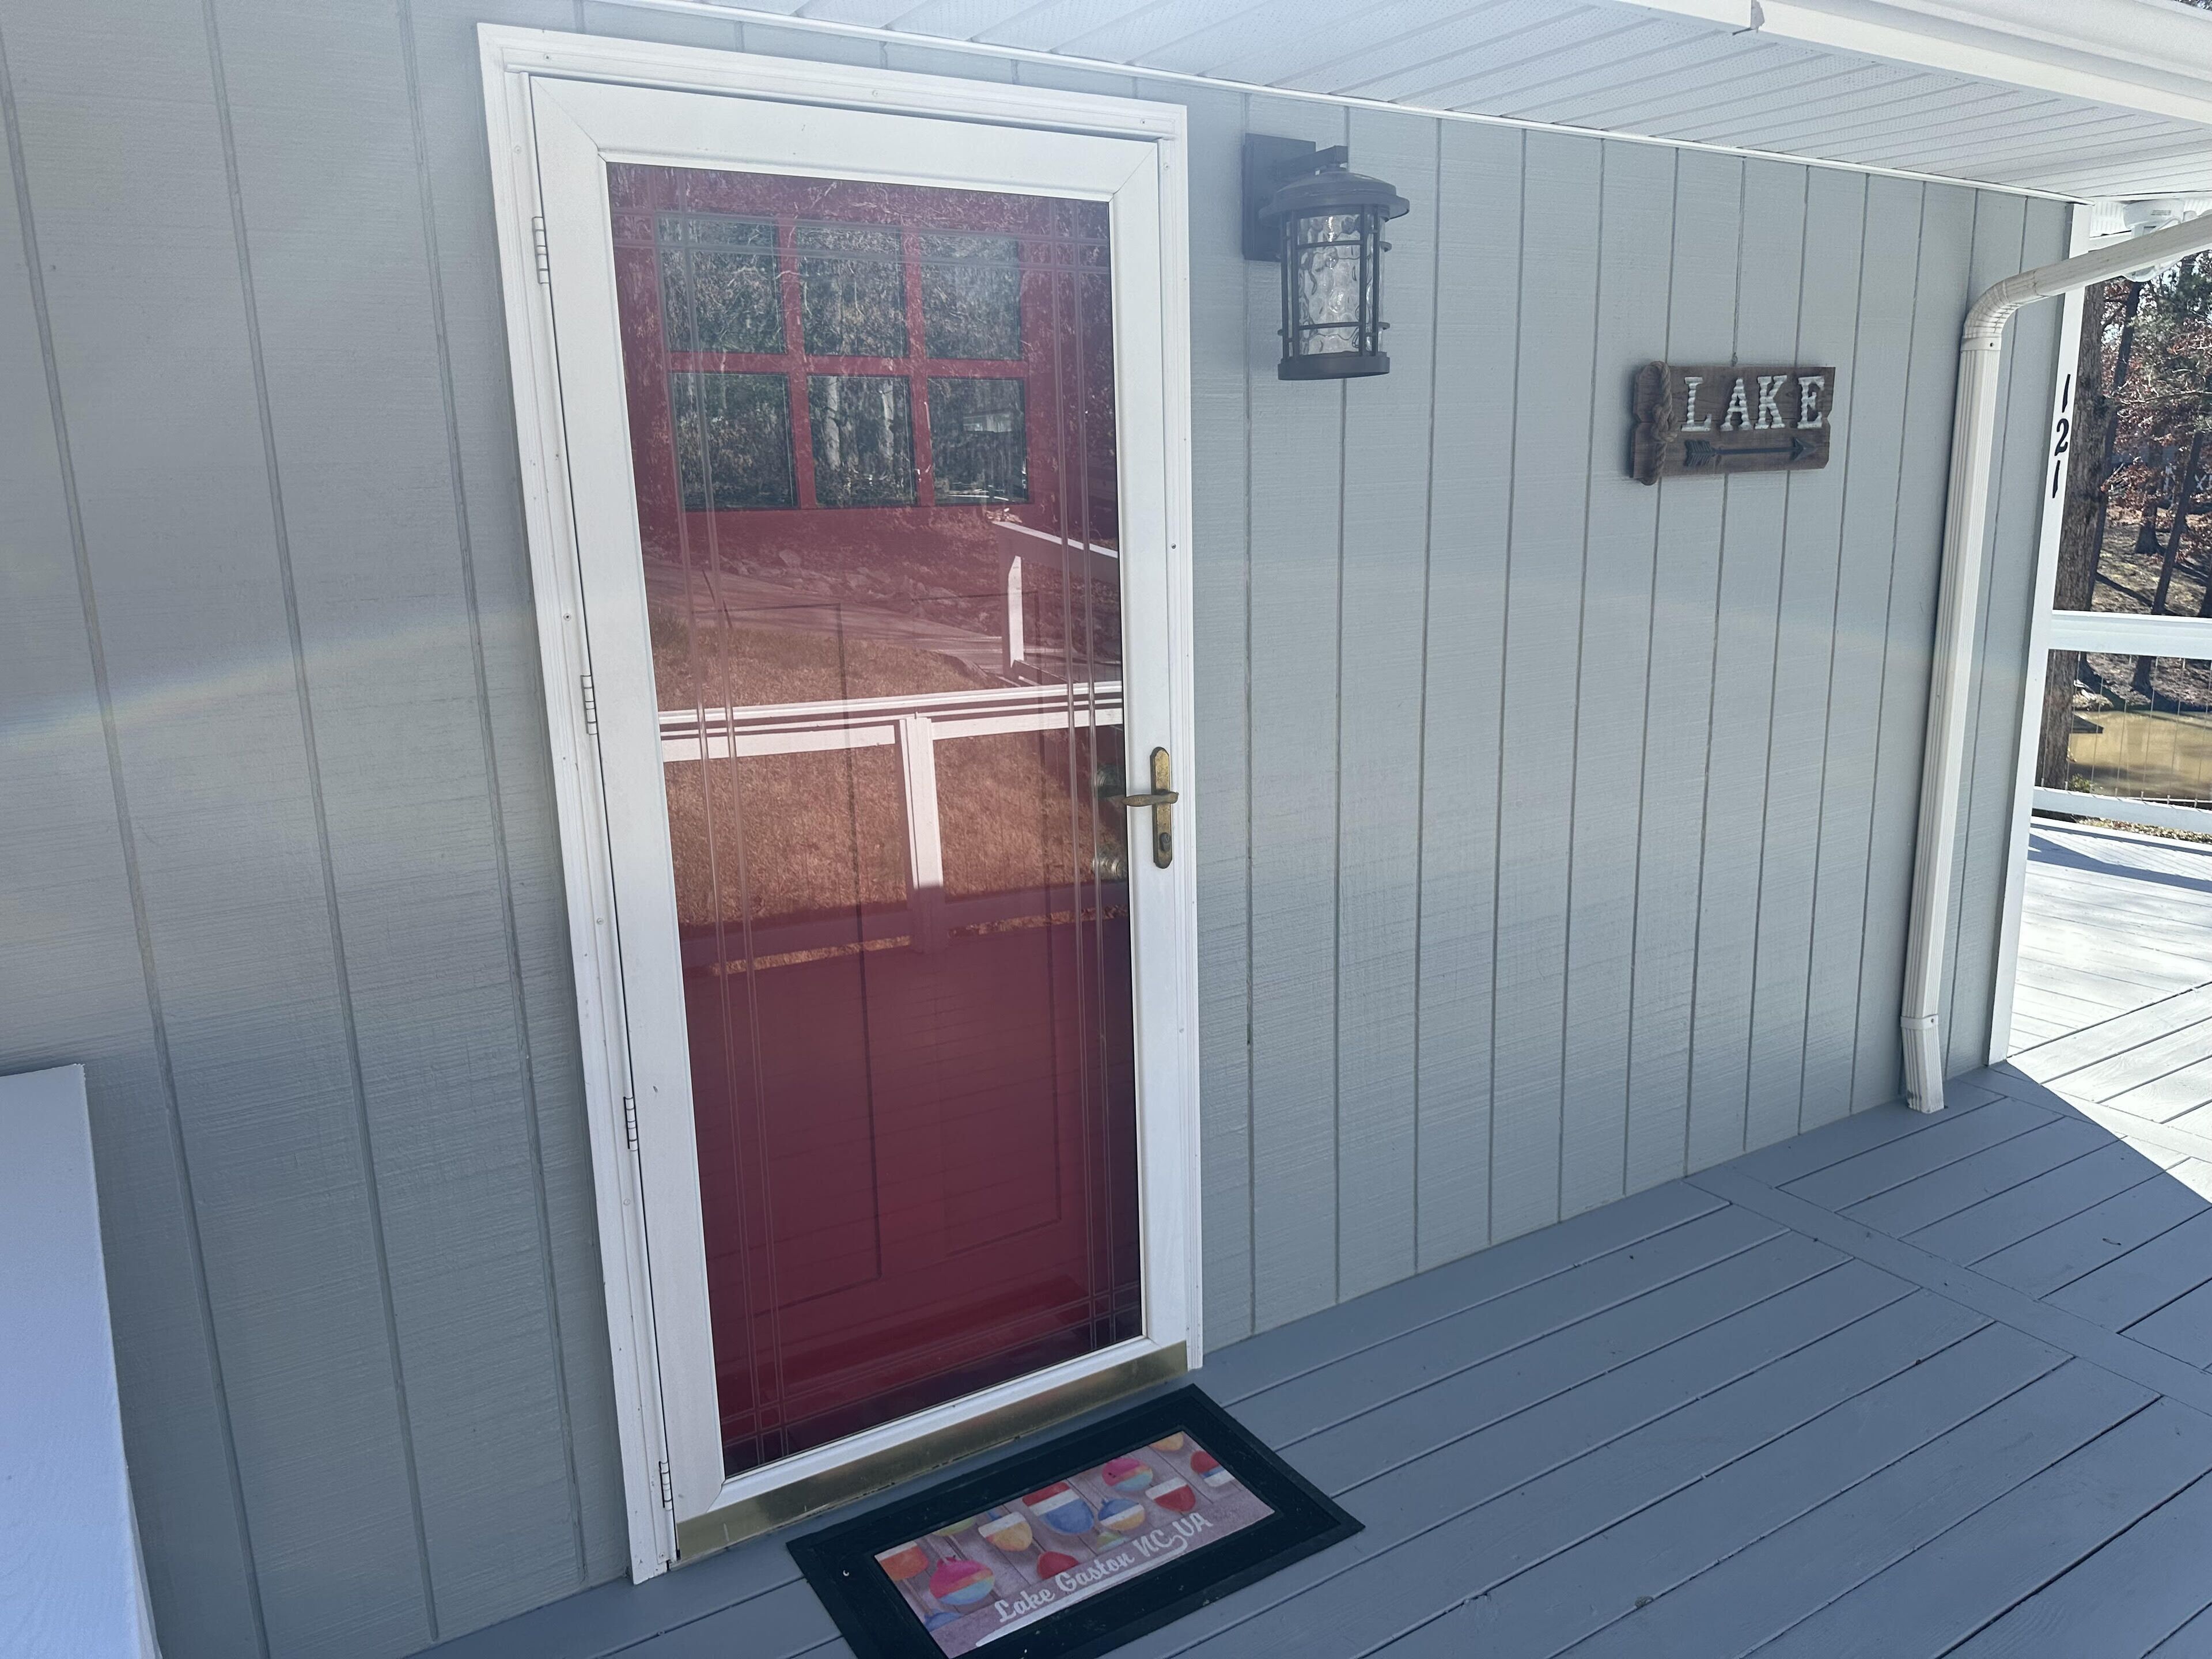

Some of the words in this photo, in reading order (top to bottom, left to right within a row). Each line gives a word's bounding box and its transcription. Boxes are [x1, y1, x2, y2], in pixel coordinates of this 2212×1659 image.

[1681, 375, 1825, 431] LAKE
[2052, 373, 2071, 499] 121
[994, 1588, 1055, 1623] Lake
[1055, 1552, 1135, 1592] Gaston
